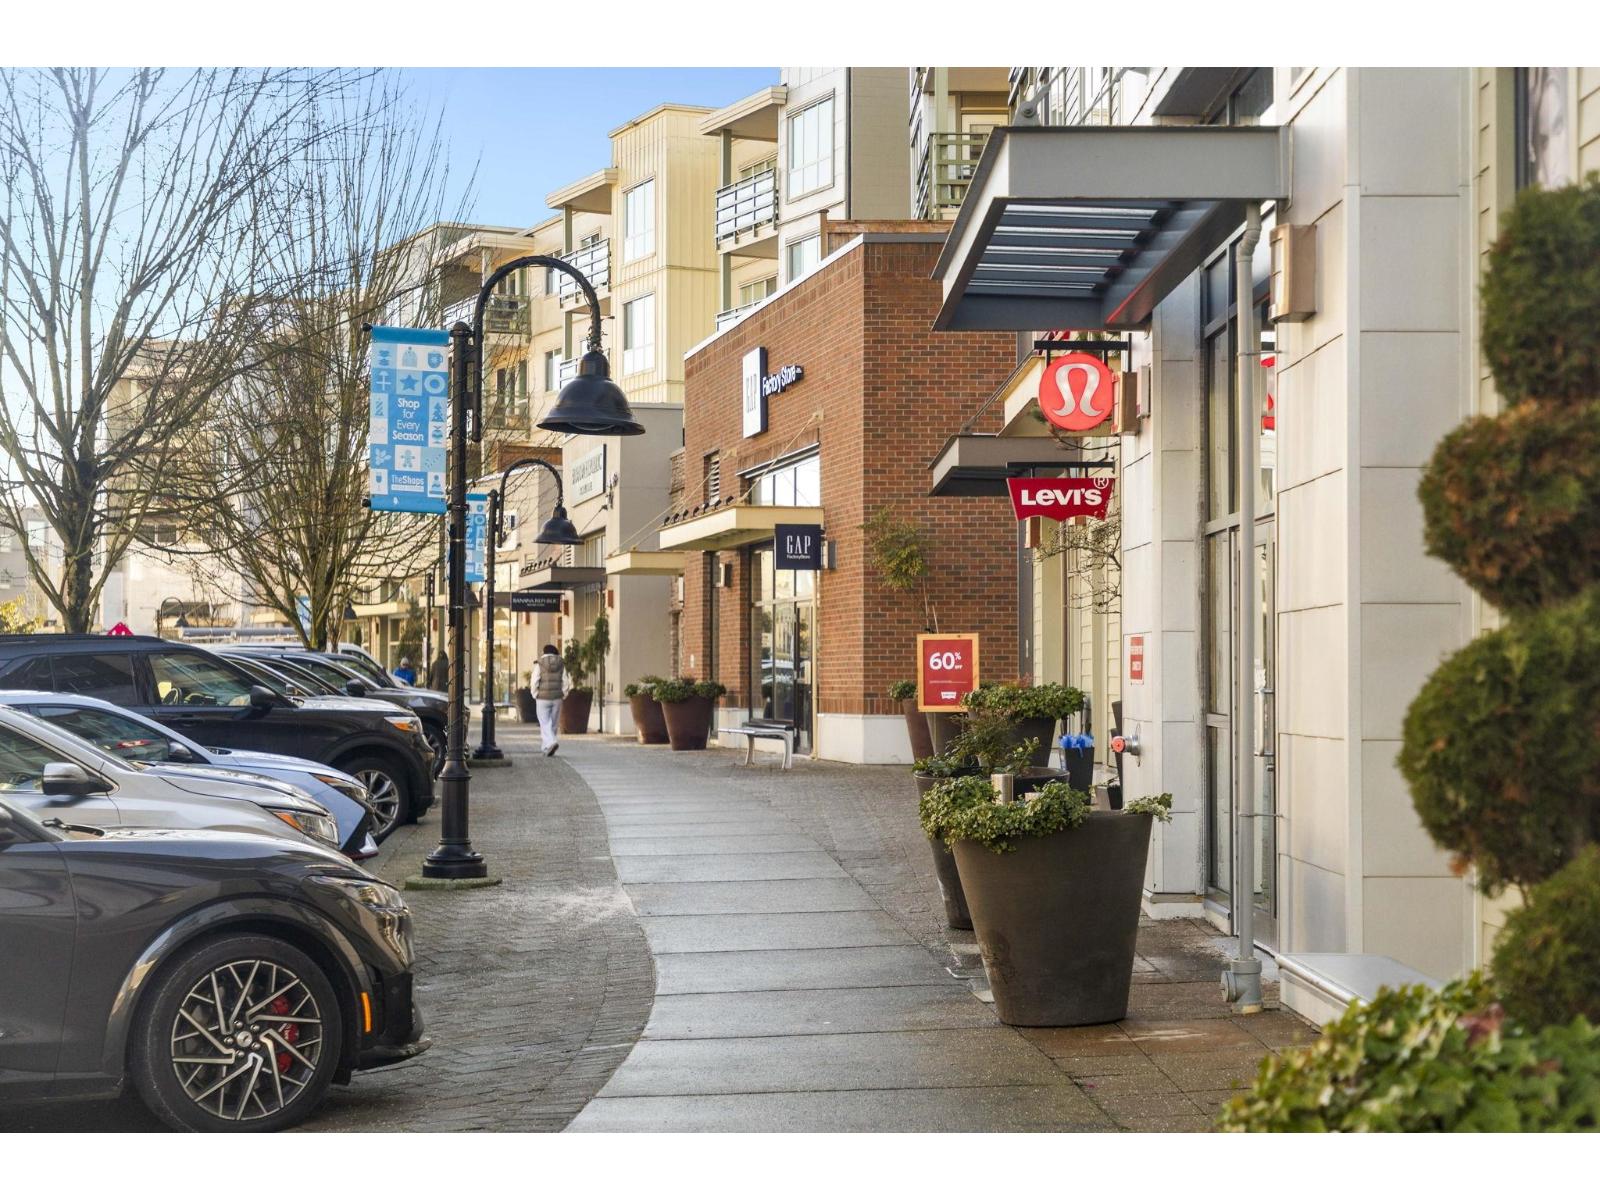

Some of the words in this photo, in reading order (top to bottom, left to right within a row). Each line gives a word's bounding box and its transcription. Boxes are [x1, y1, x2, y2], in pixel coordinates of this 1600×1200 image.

[397, 398, 420, 410] Shop
[402, 408, 415, 418] for
[396, 419, 420, 432] Every
[392, 430, 424, 441] Season
[786, 535, 811, 554] GAP
